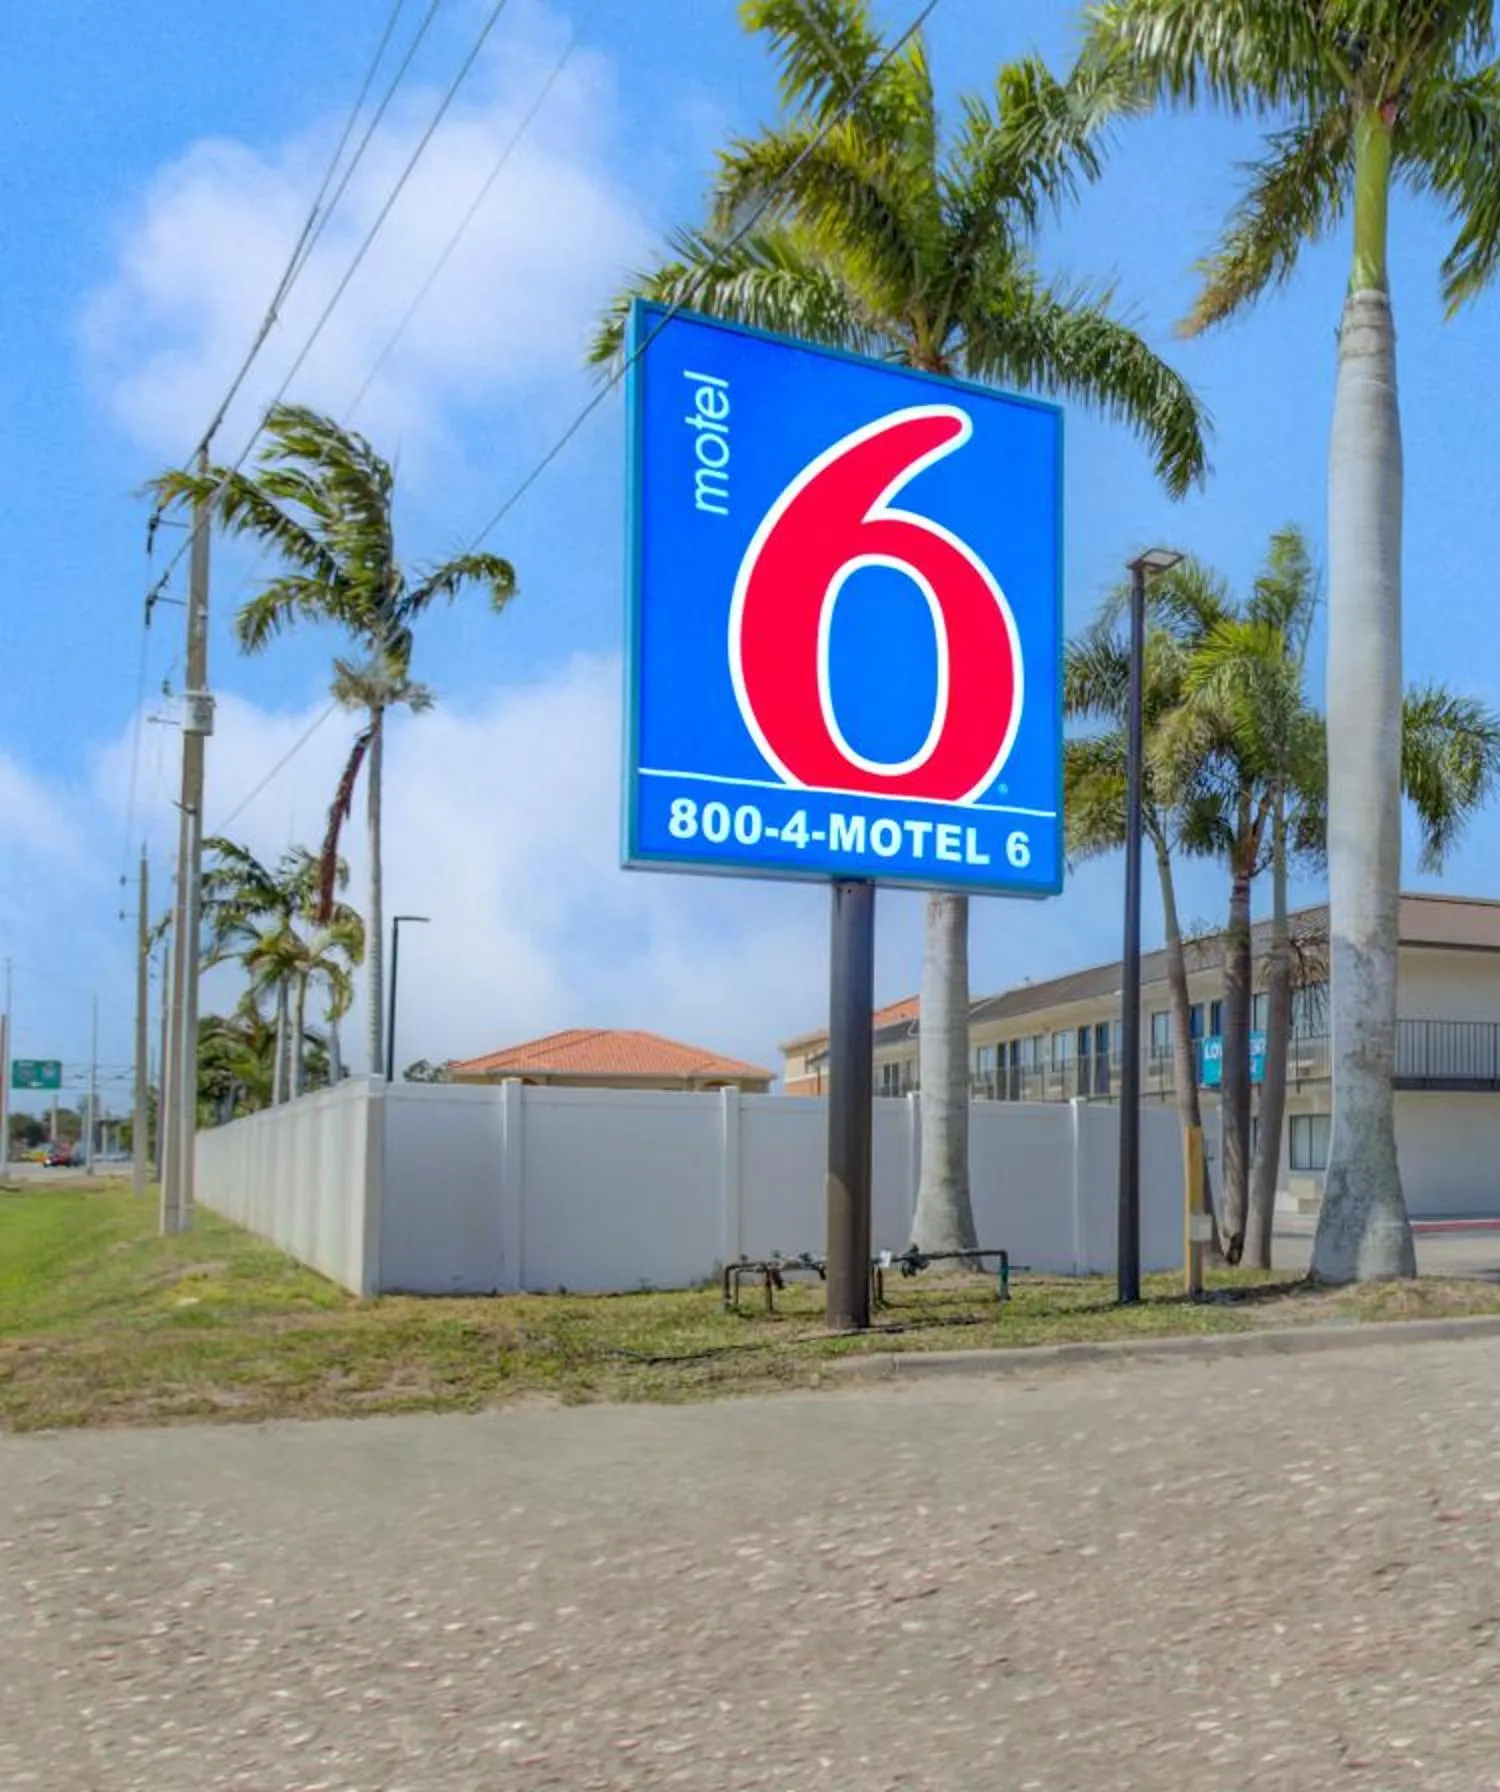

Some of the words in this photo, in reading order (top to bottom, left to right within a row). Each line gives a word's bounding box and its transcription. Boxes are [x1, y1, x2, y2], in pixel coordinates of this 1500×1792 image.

[683, 369, 729, 515] motel
[728, 404, 1024, 805] 6
[668, 798, 990, 865] 800-4-MOTEL
[1005, 831, 1031, 868] 6
